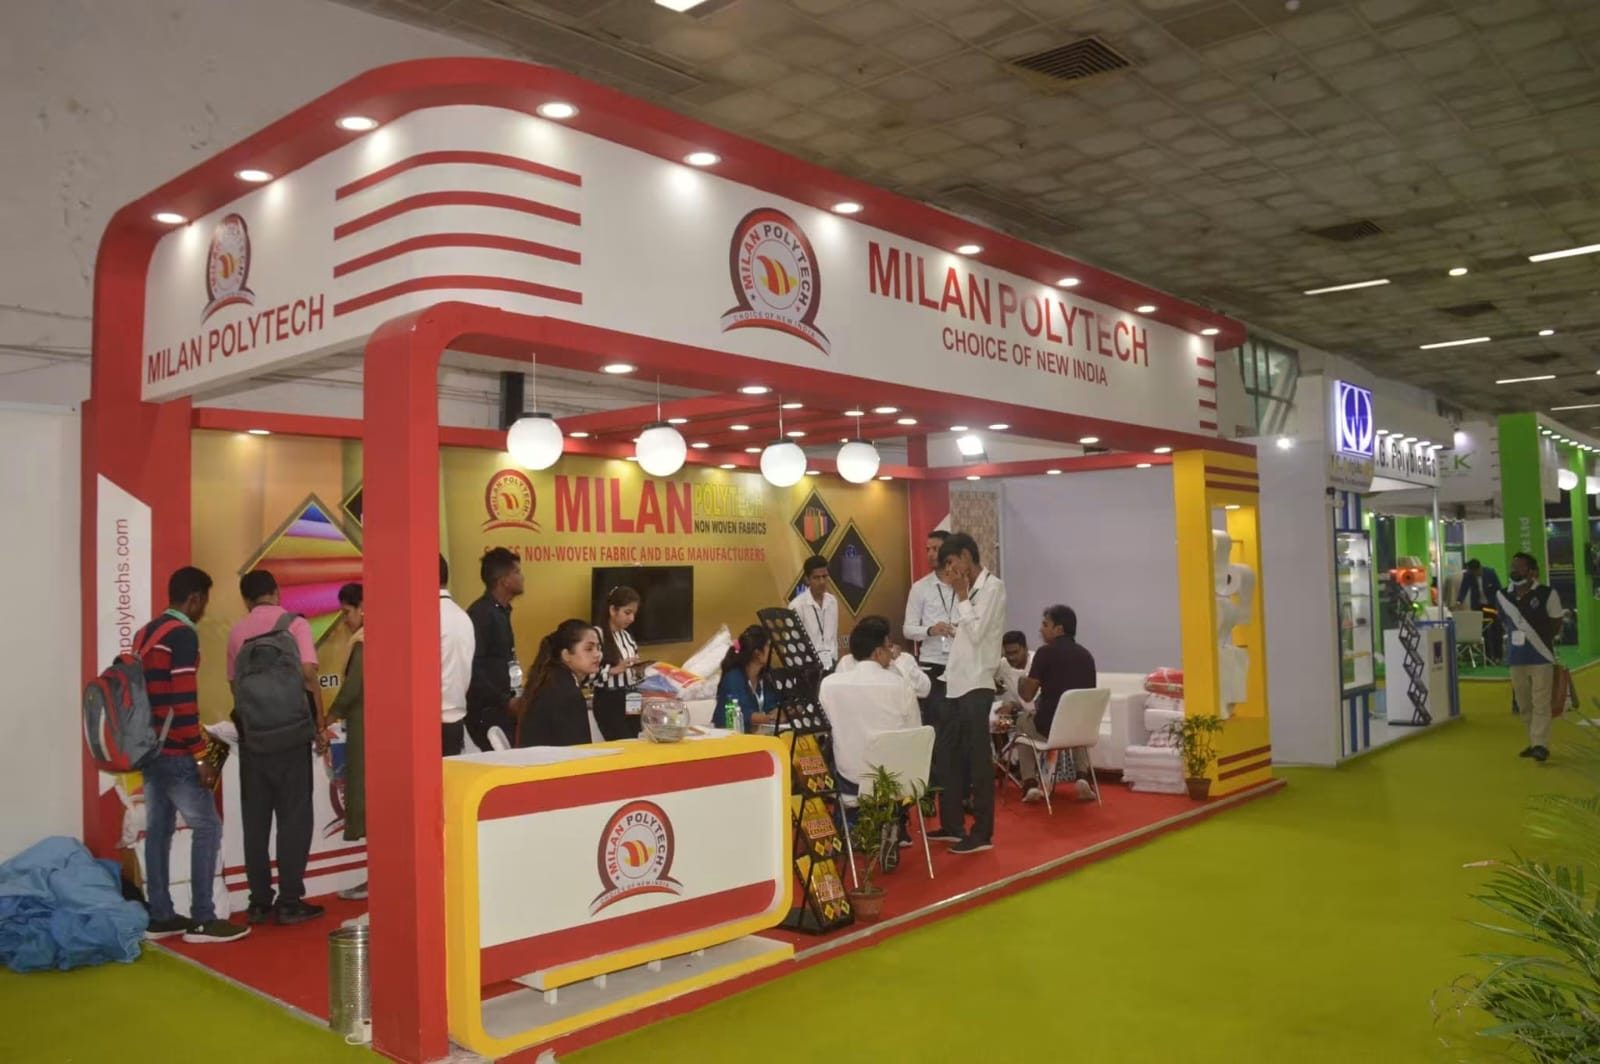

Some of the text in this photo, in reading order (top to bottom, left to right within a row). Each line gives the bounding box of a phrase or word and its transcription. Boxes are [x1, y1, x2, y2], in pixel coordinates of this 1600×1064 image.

[741, 224, 811, 306] MILAN POLYTECH
[868, 241, 1149, 367] MILAN POLYTECH
[147, 294, 324, 385] MILAN POLYTECH
[943, 327, 1108, 387] CHOICE OF NEW INDIA
[554, 475, 692, 535] MILAN
[695, 519, 767, 536] NON WOVEN FABRICS
[525, 546, 597, 561] NON-WOVEN
[600, 546, 637, 561] FABRIC
[640, 547, 661, 561] AND
[664, 547, 685, 561] BAG
[687, 547, 765, 562] MANUFACTURERS
[607, 812, 666, 875] MILAN POLYTECH
